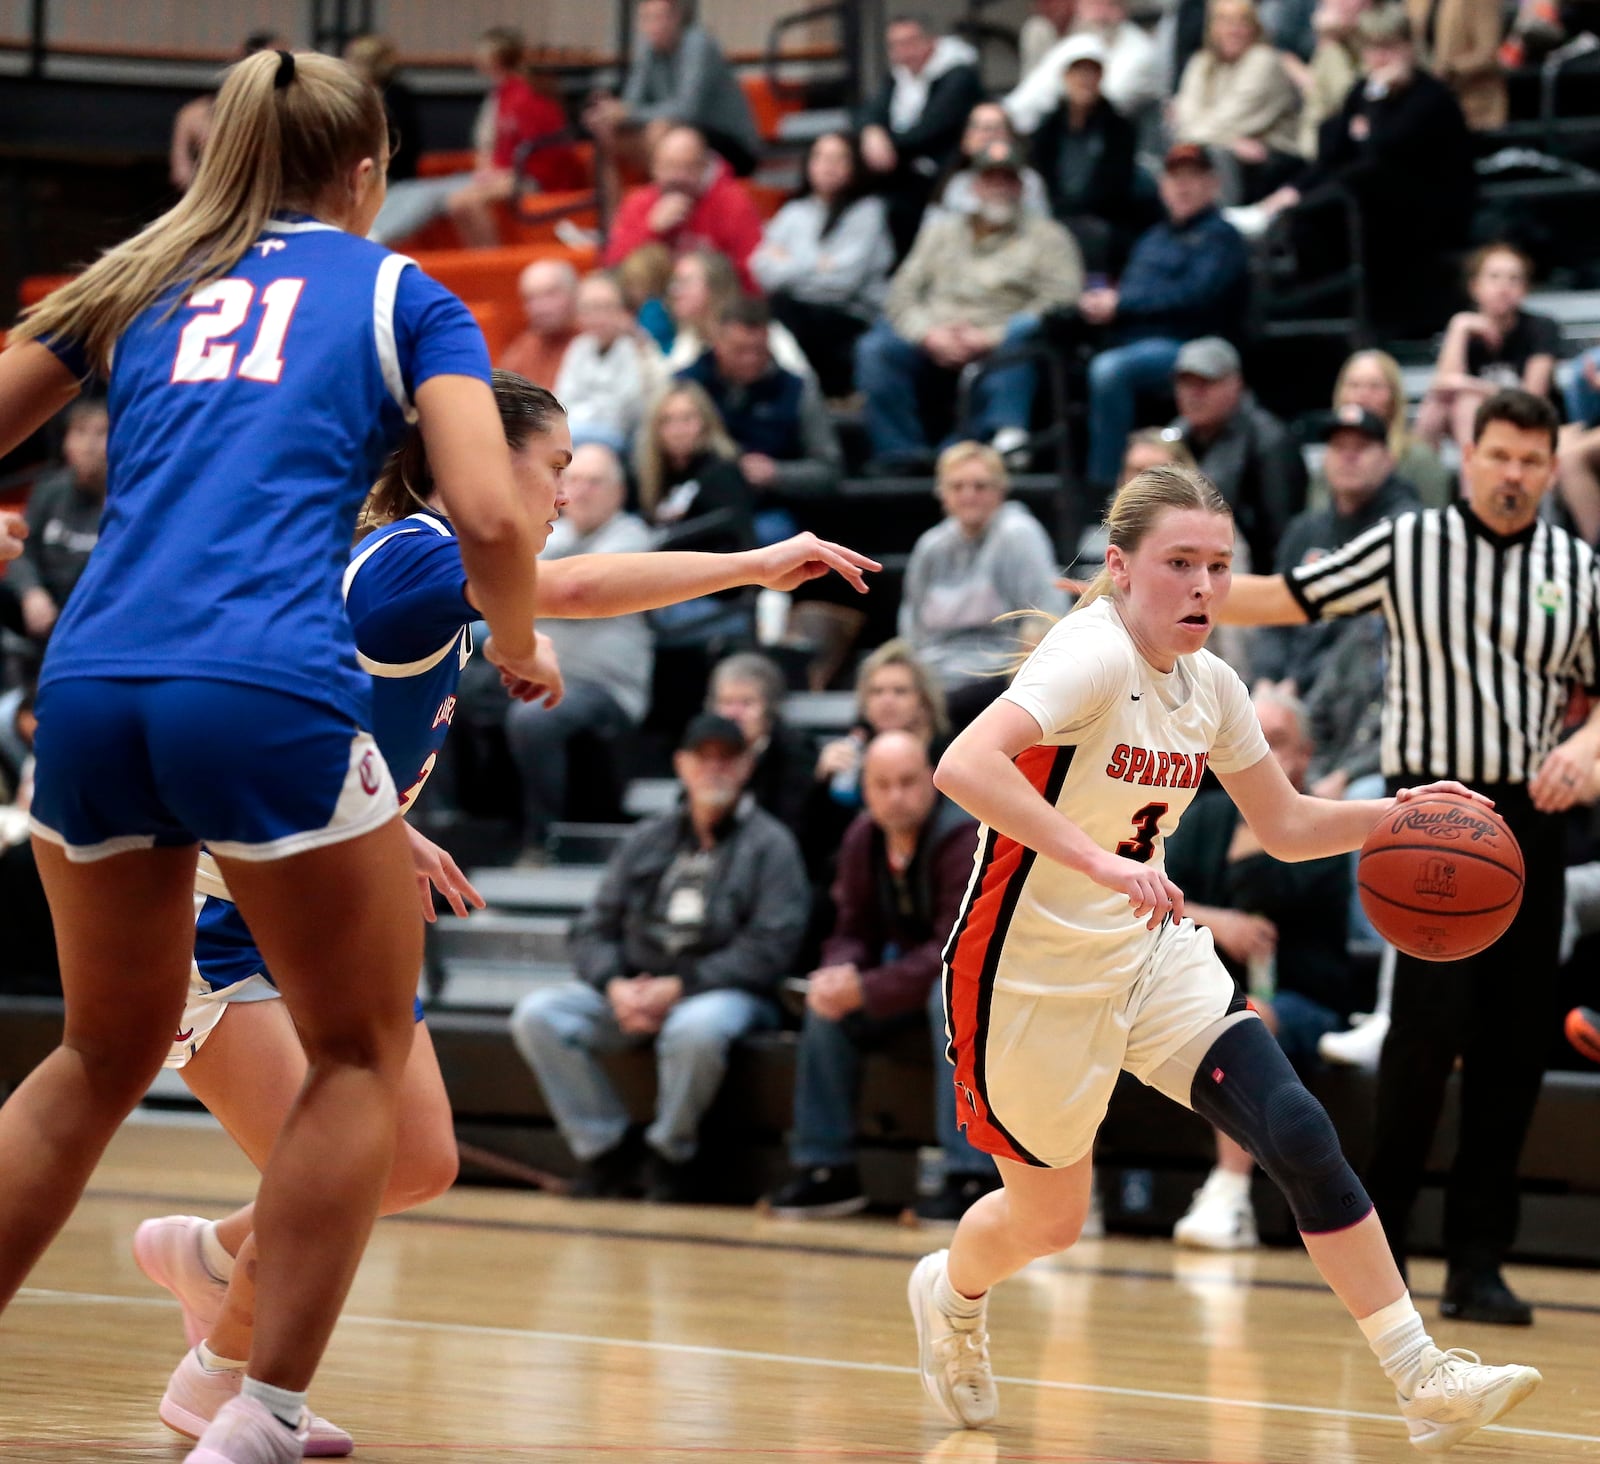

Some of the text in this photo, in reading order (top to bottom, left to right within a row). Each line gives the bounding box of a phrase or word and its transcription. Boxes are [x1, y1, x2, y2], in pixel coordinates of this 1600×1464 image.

[170, 277, 306, 385] 21
[1106, 744, 1209, 788] SPARTAN
[1115, 802, 1168, 864] 3
[1391, 808, 1498, 841] Rawlings
